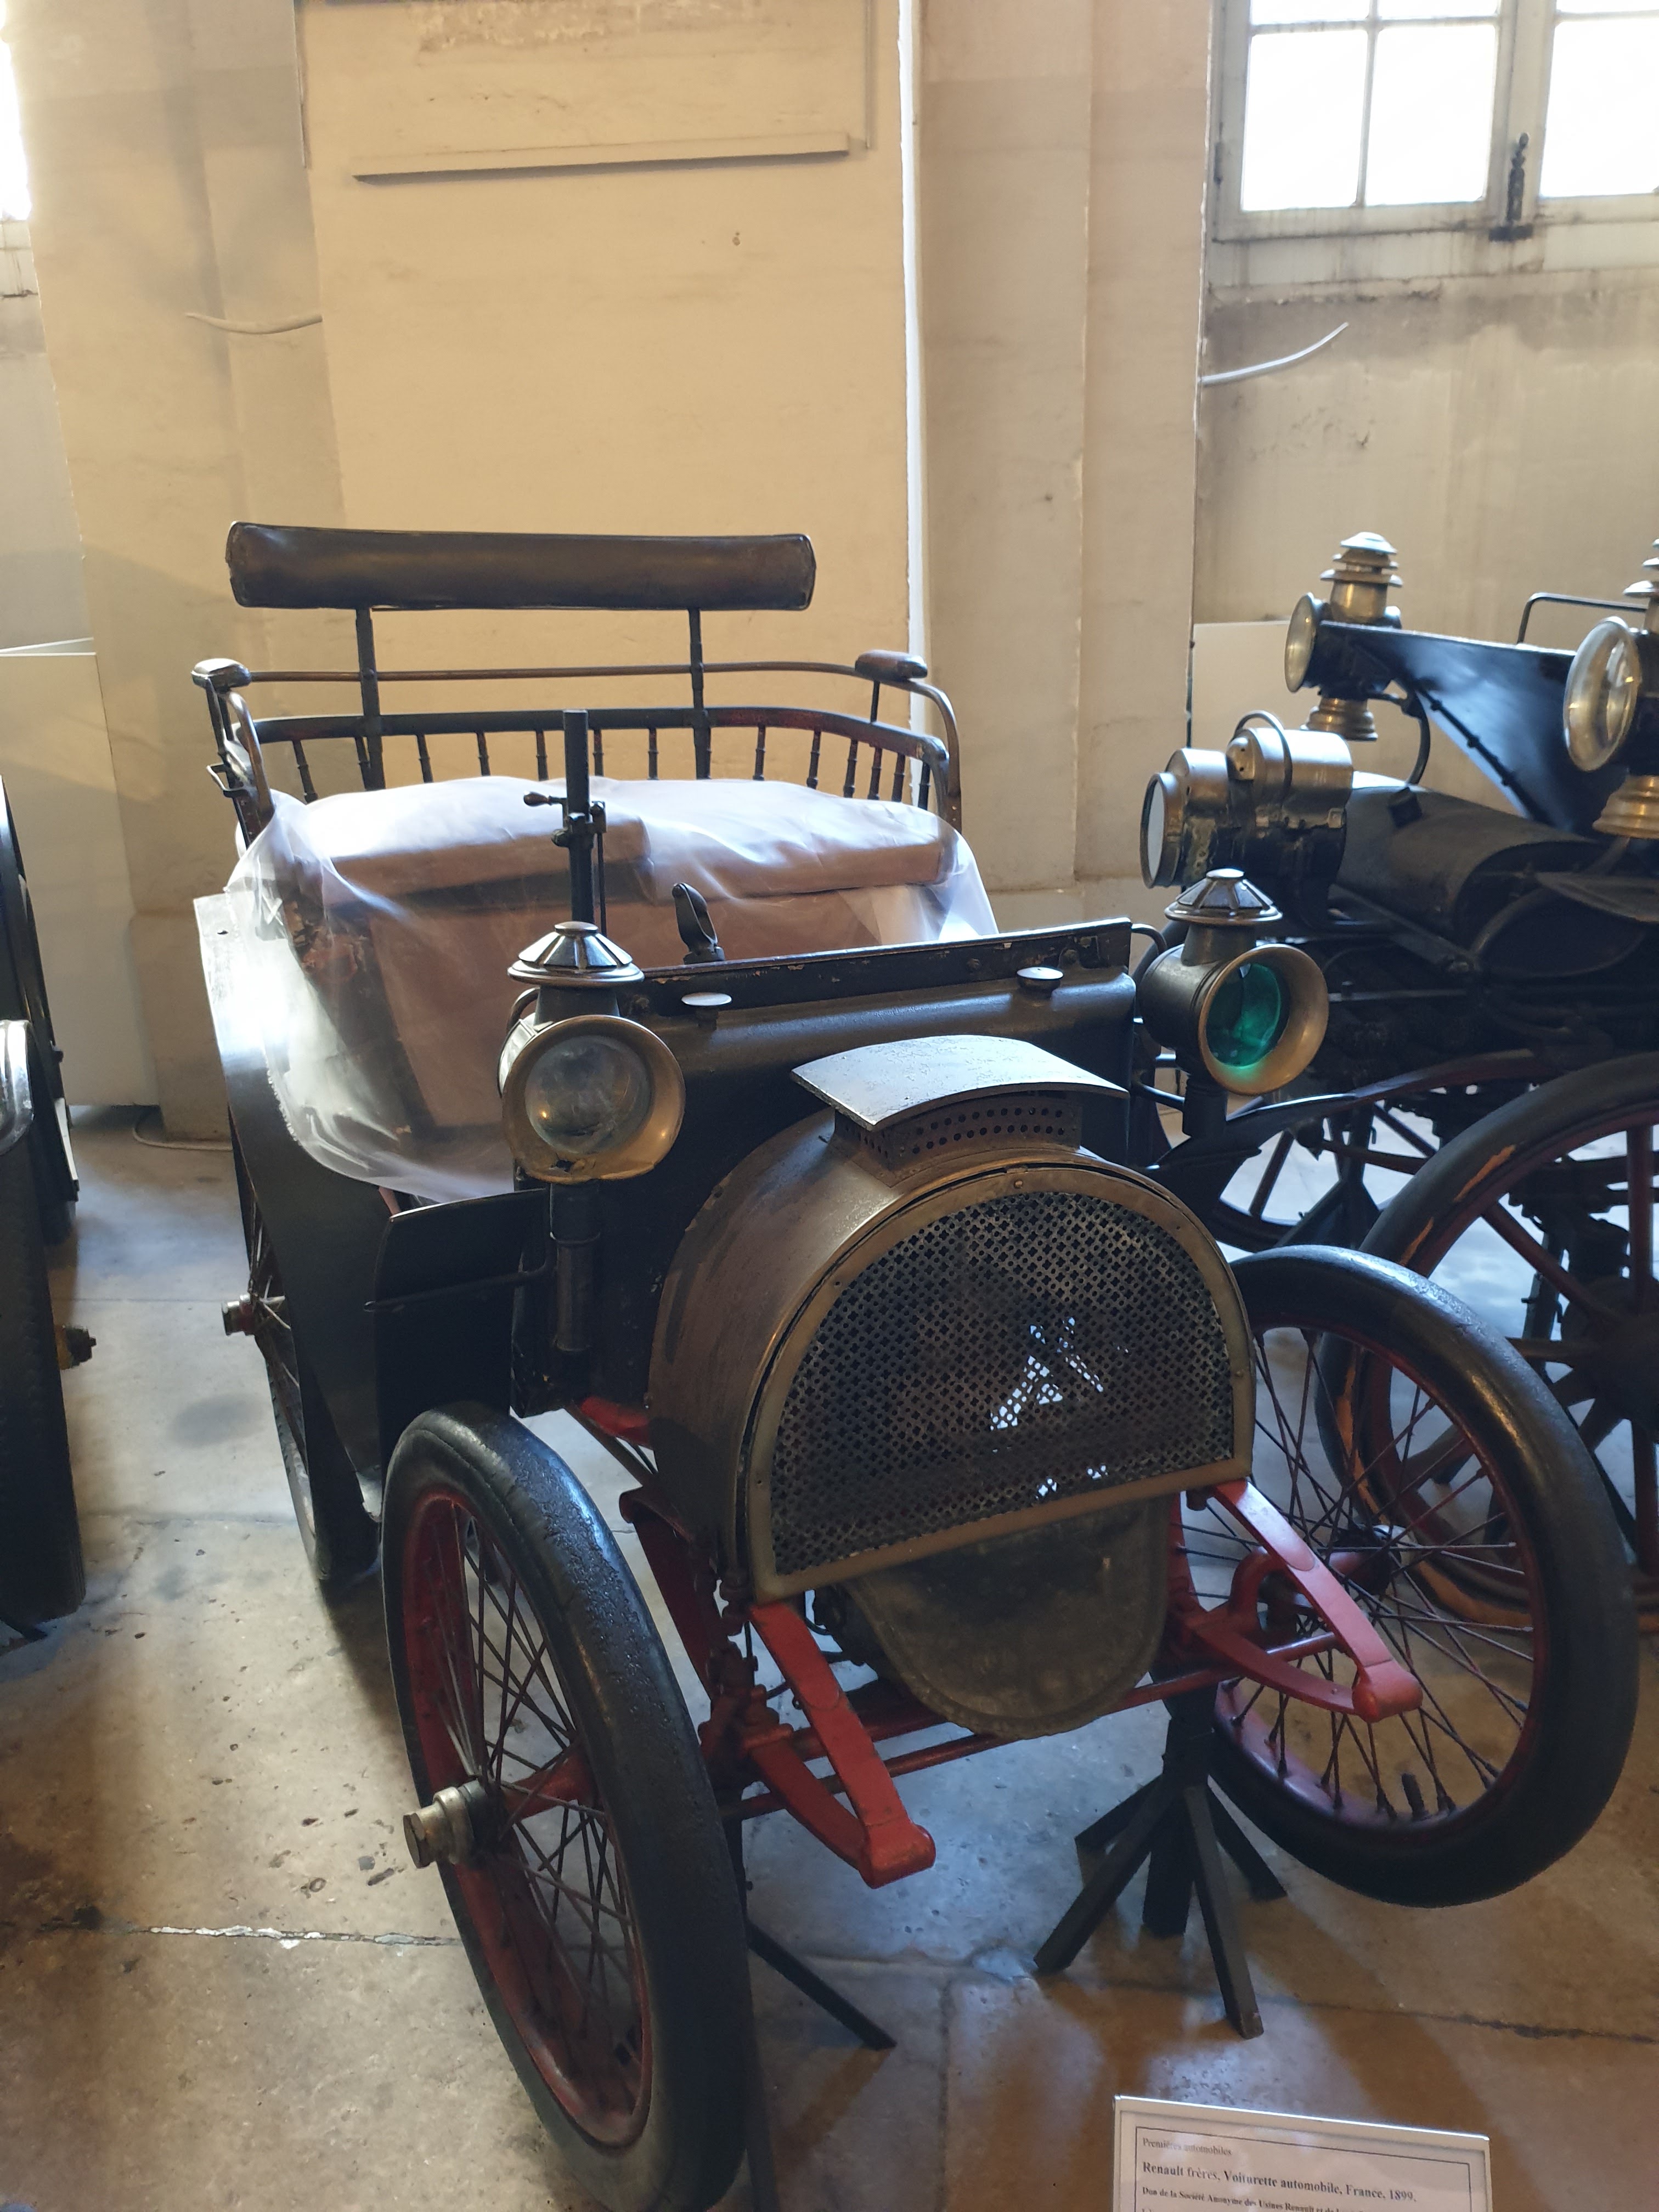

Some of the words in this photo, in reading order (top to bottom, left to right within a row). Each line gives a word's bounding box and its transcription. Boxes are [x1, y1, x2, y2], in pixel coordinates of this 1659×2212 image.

[1184, 2145, 1232, 2156] automobiles
[1143, 2162, 1183, 2176] Renault
[1187, 2166, 1220, 2181] frères,
[1224, 2170, 1278, 2187] Voiturette
[1143, 2186, 1158, 2195] Don
[1180, 2191, 1205, 2201] Société
[1208, 2194, 1242, 2205] Anonyme
[1259, 2199, 1283, 2209] Usines
